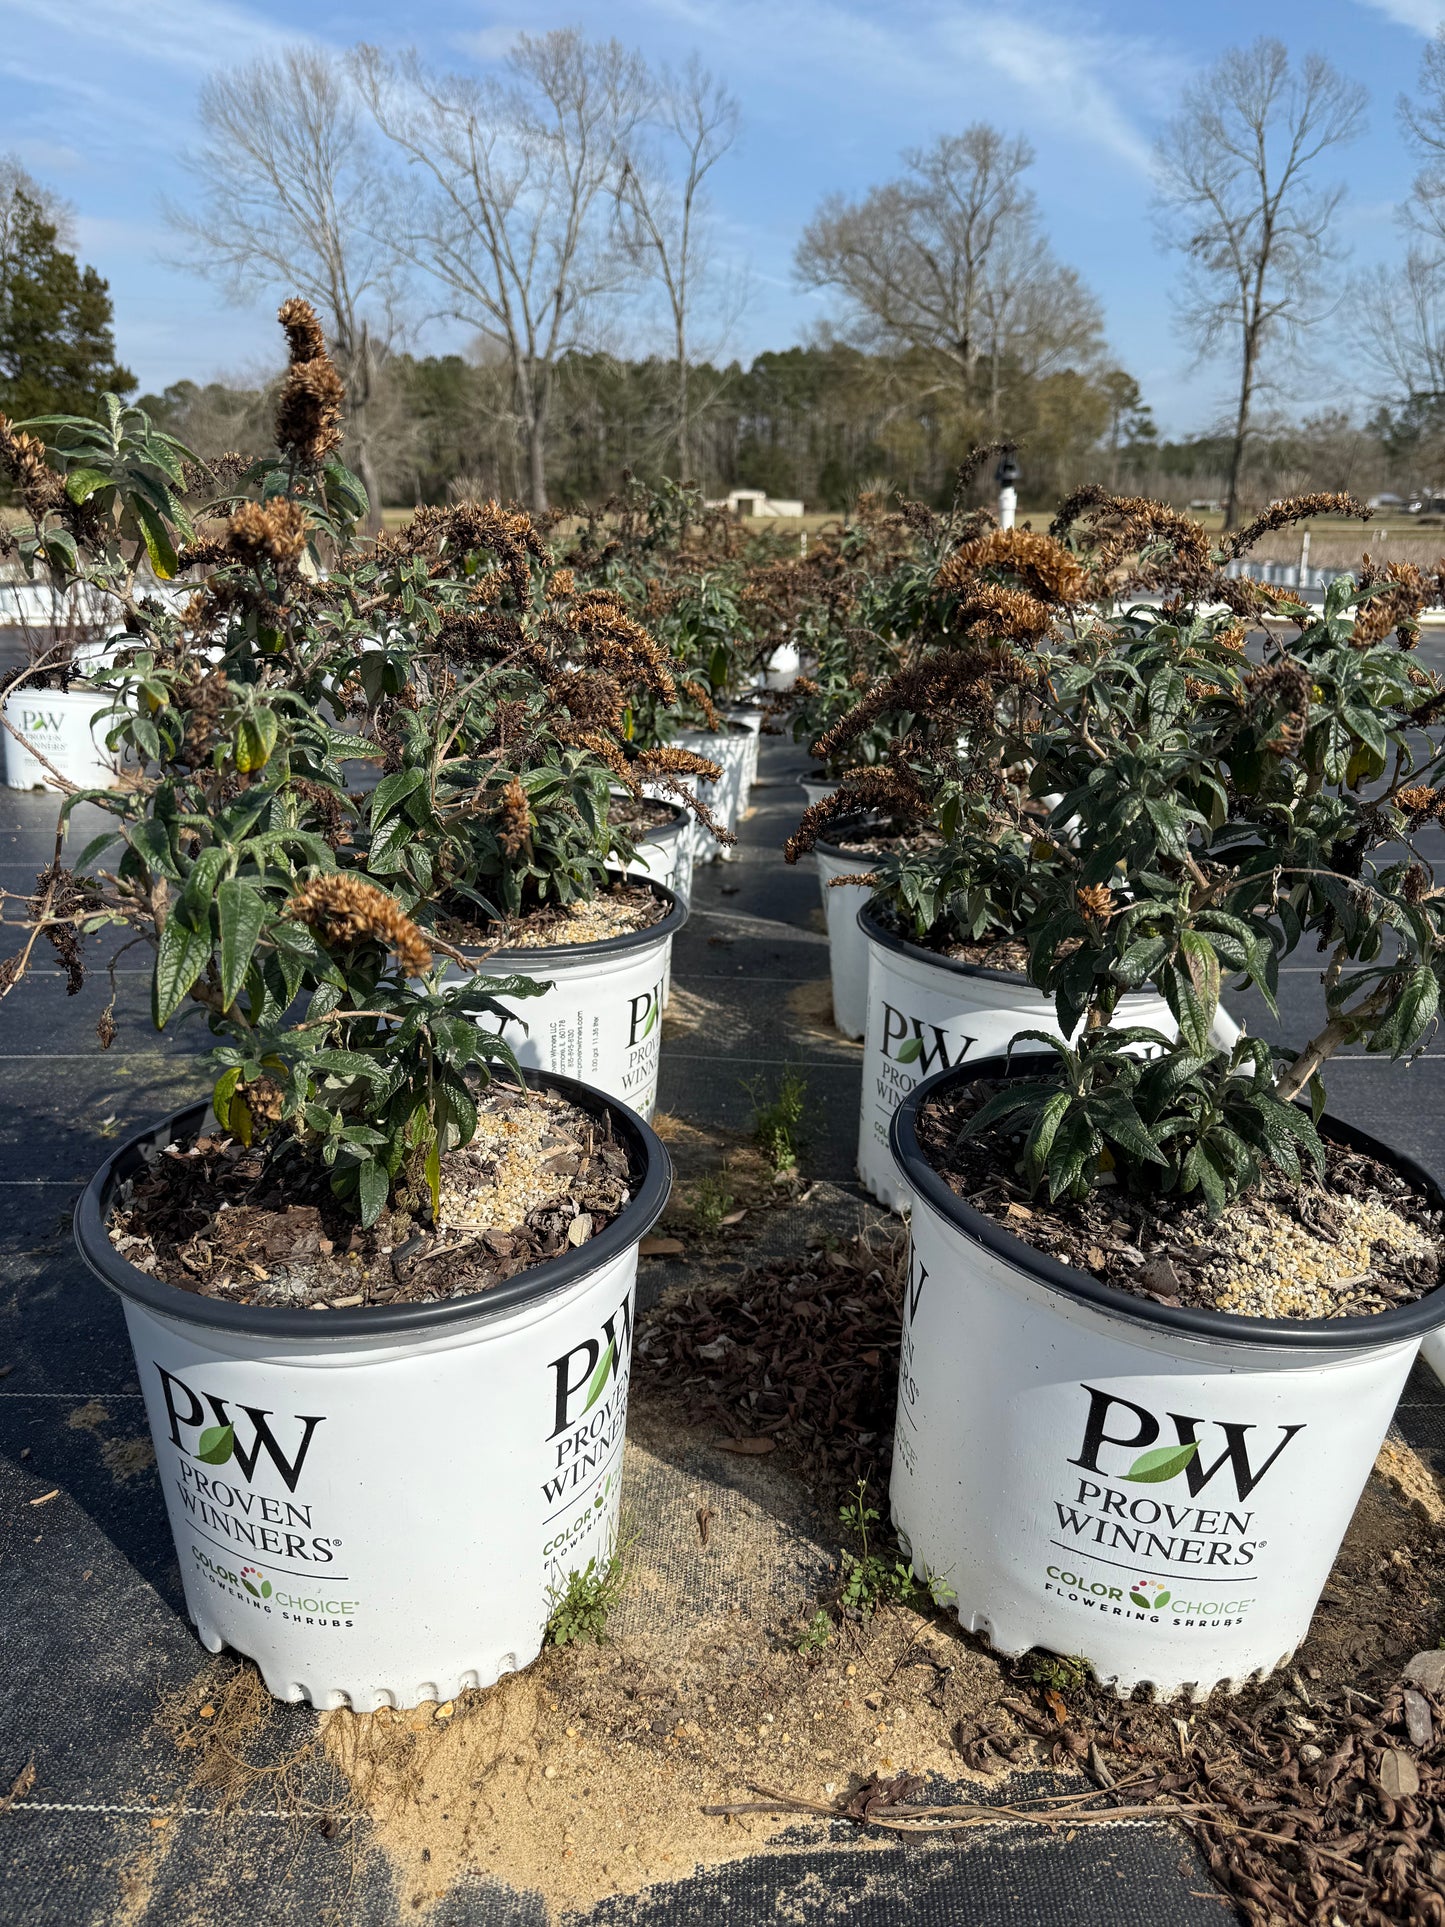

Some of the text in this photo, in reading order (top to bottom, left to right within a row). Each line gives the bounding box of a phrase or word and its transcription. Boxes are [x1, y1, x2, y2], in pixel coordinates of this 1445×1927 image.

[22, 710, 65, 731] PW
[880, 1000, 979, 1076] PW
[152, 1360, 327, 1493] PW
[1066, 1383, 1307, 1503] PW
[178, 1456, 313, 1530] PROVEN
[1074, 1477, 1255, 1535] PROVEN
[543, 1508, 592, 1556] COLOR
[191, 1545, 240, 1587] COLOR
[1046, 1565, 1123, 1602] COLOR
[196, 1563, 354, 1628] FLOWERING SHRUBS
[1045, 1582, 1243, 1627] FLOWERING SHRUBS
